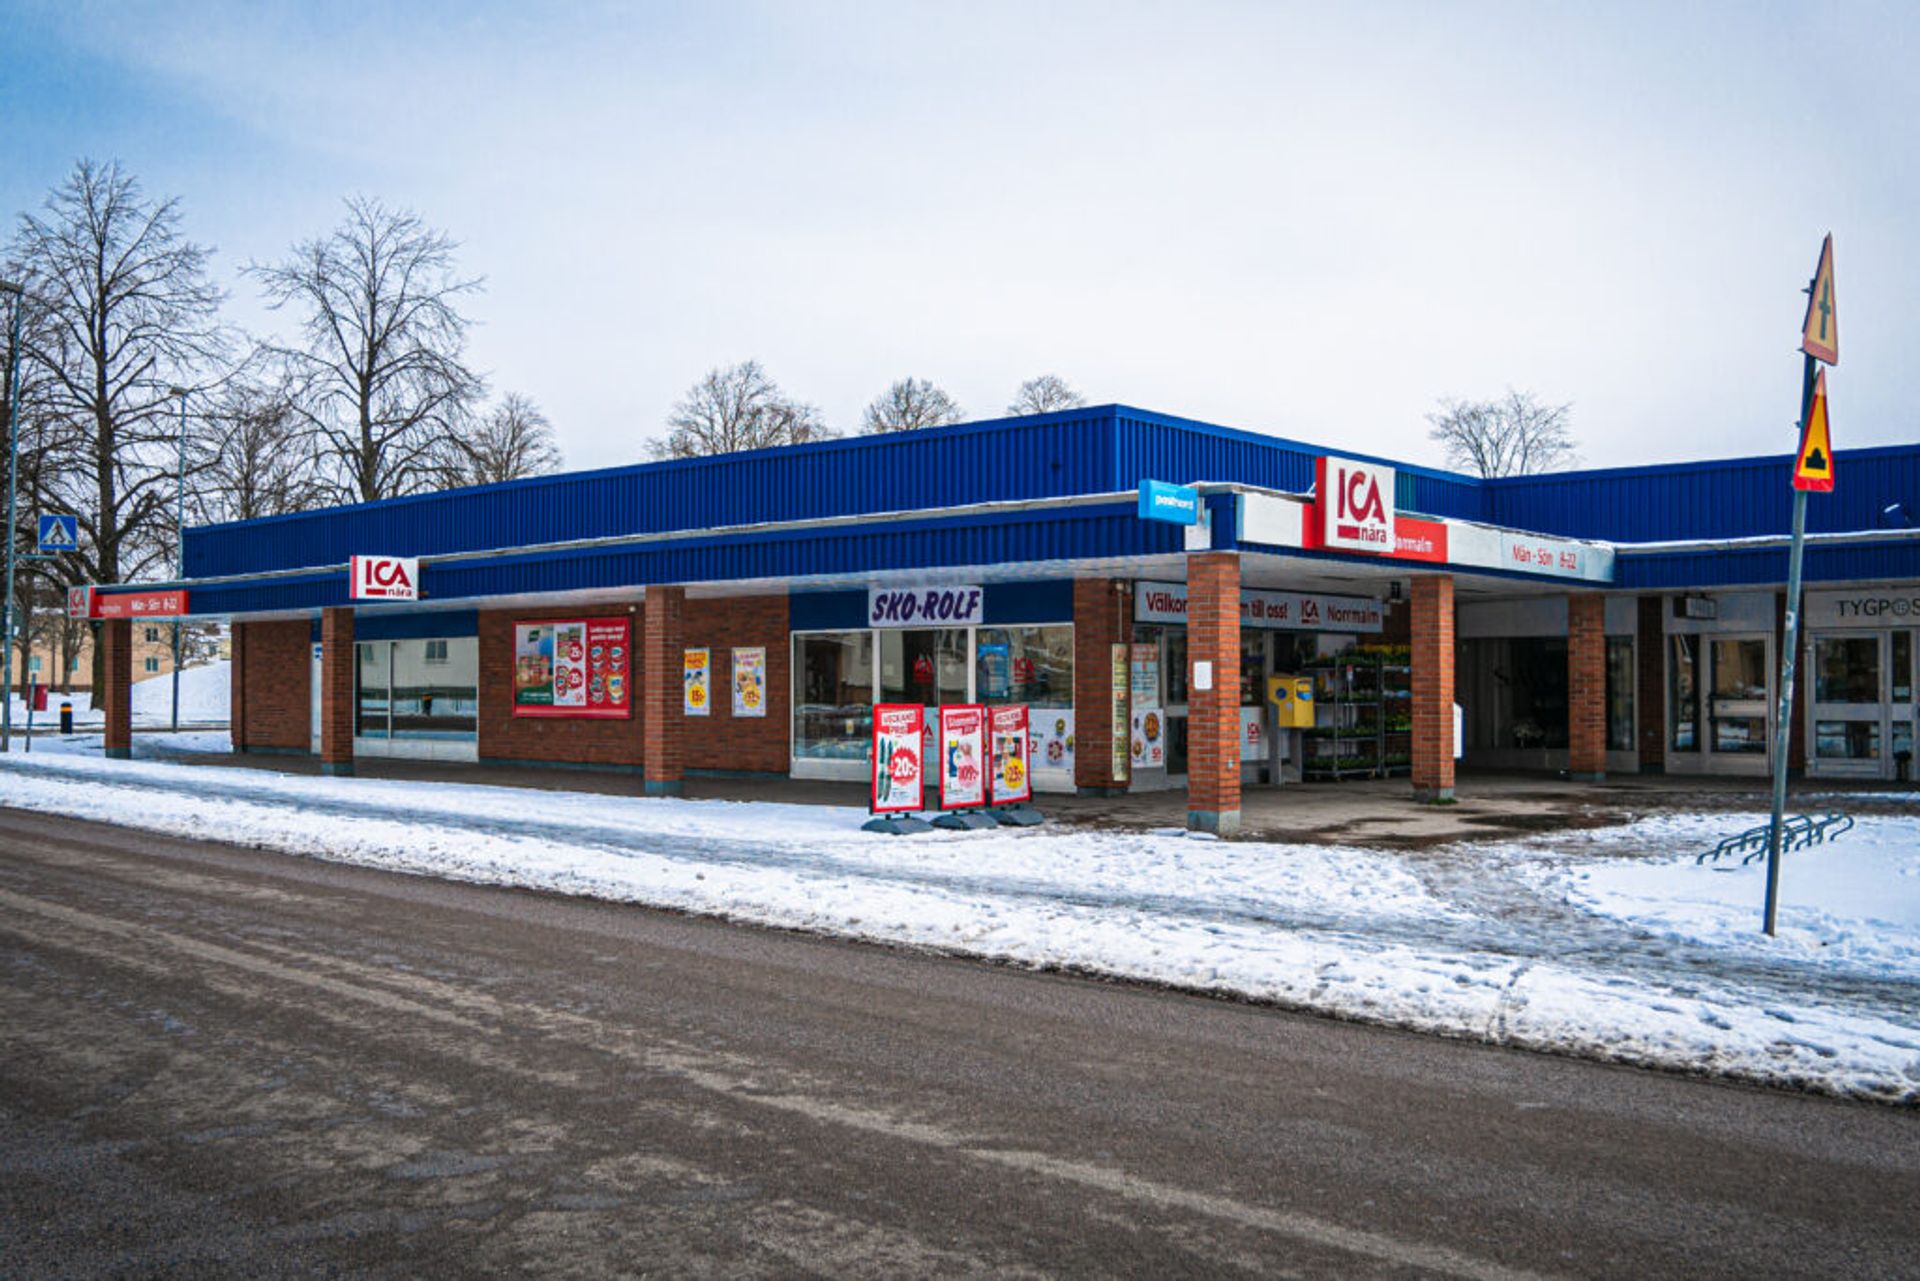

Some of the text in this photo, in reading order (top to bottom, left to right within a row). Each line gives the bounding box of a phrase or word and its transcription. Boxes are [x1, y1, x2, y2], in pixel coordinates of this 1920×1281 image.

[1337, 467, 1387, 525] ICA
[1361, 523, 1387, 544] nära
[366, 560, 411, 588] ICA
[388, 588, 412, 597] nära
[1251, 600, 1264, 617] till
[1301, 600, 1319, 618] ICA
[1327, 604, 1380, 625] Norrmalm
[1013, 656, 1035, 673] ICA
